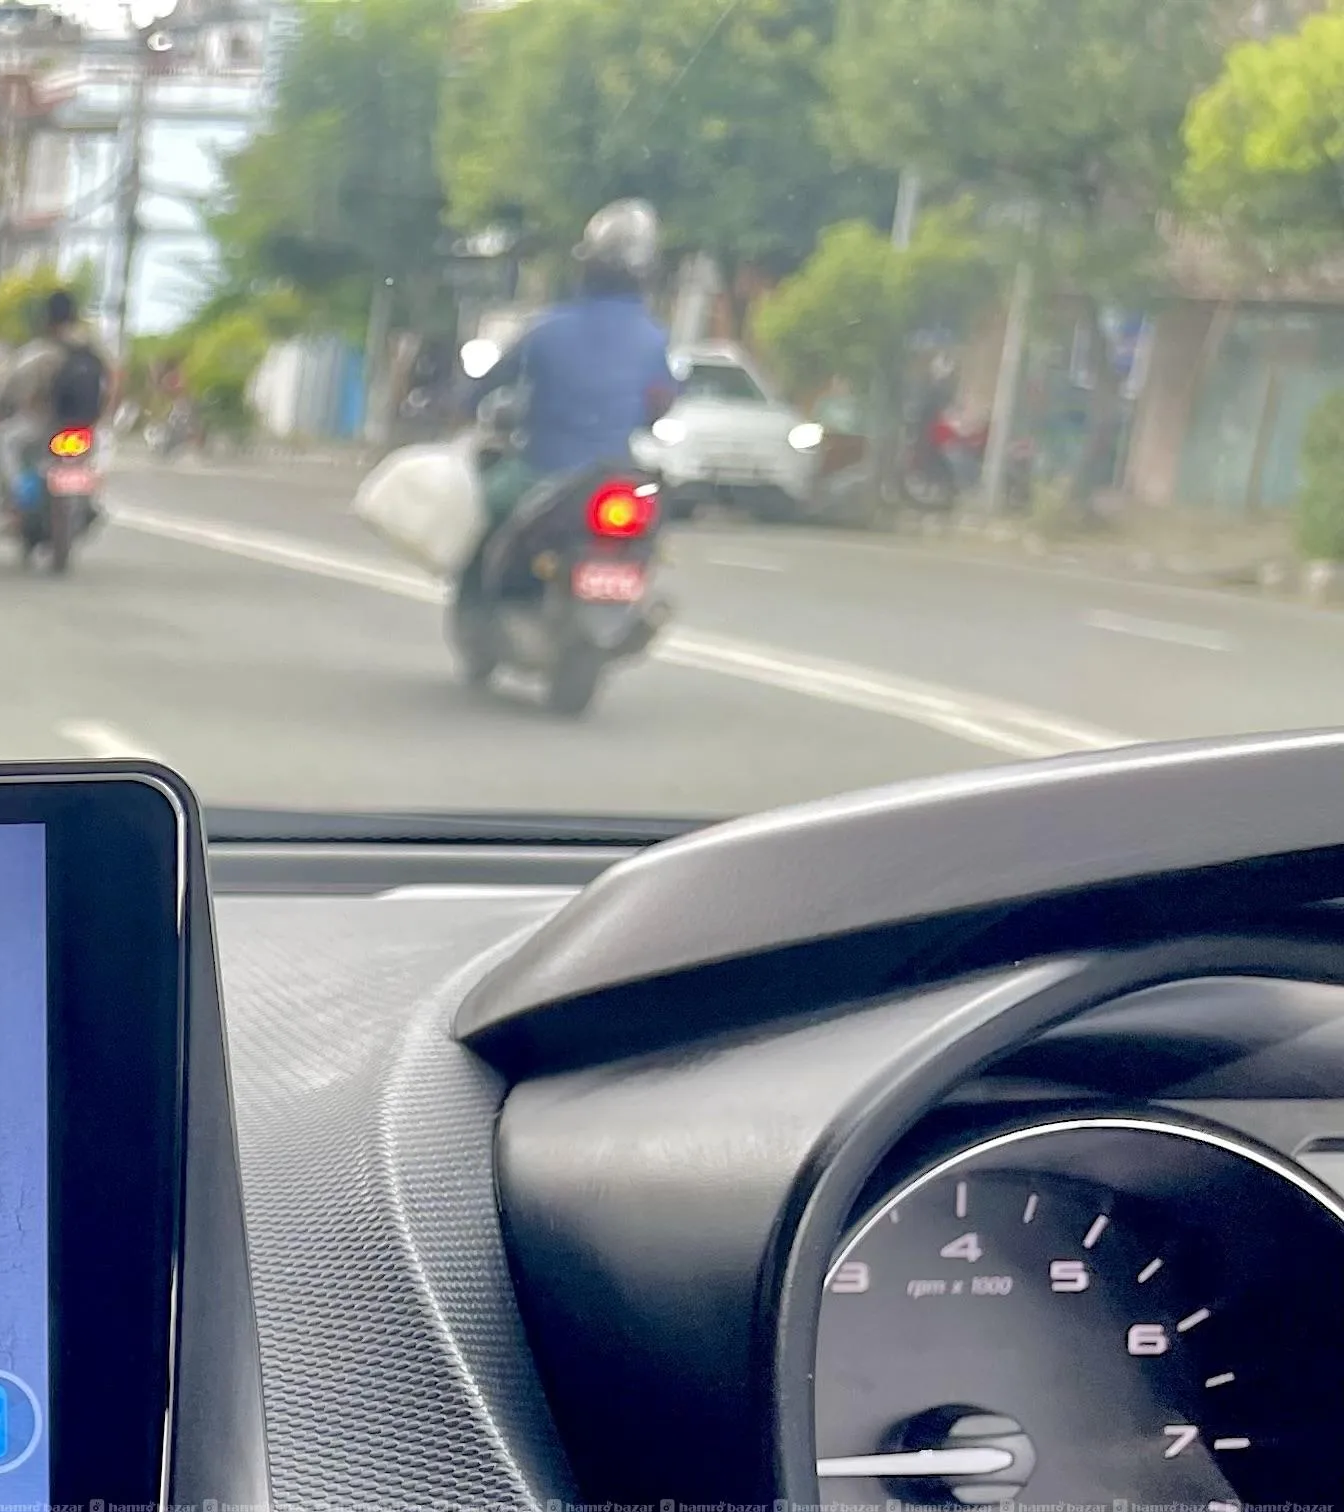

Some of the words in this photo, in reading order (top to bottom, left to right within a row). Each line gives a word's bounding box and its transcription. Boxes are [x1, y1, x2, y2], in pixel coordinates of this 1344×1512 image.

[940, 1232, 983, 1263] 4
[830, 1260, 870, 1294] 3
[907, 1279, 947, 1299] rpm
[1049, 1260, 1090, 1292] 5
[1127, 1322, 1170, 1356] 6
[1163, 1425, 1200, 1460] 7
